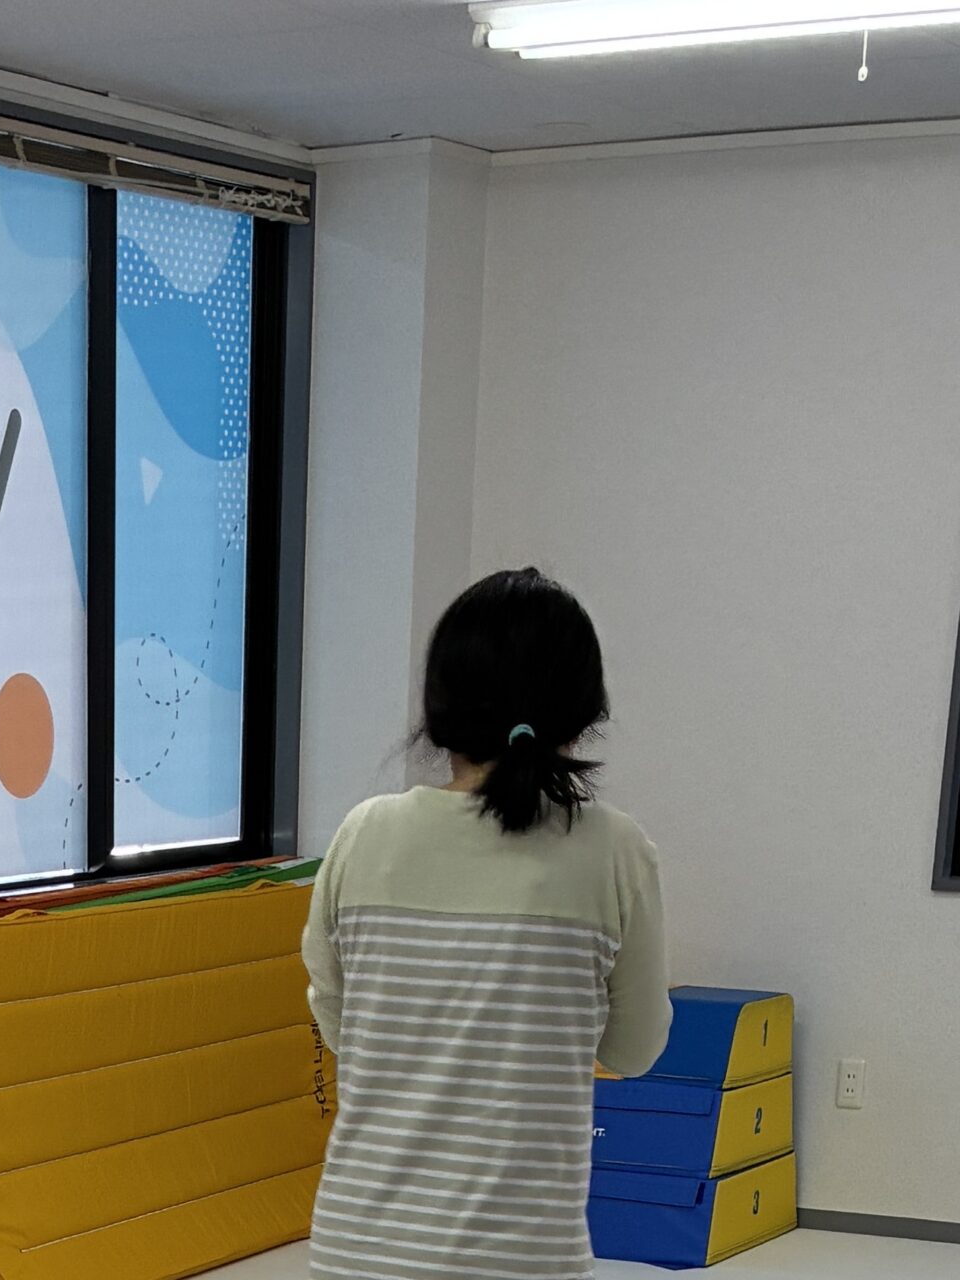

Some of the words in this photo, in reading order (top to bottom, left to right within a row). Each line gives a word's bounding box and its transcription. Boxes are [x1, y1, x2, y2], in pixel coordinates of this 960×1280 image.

[762, 1019, 769, 1047] 1
[754, 1107, 763, 1135] 2
[752, 1189, 760, 1215] 3
